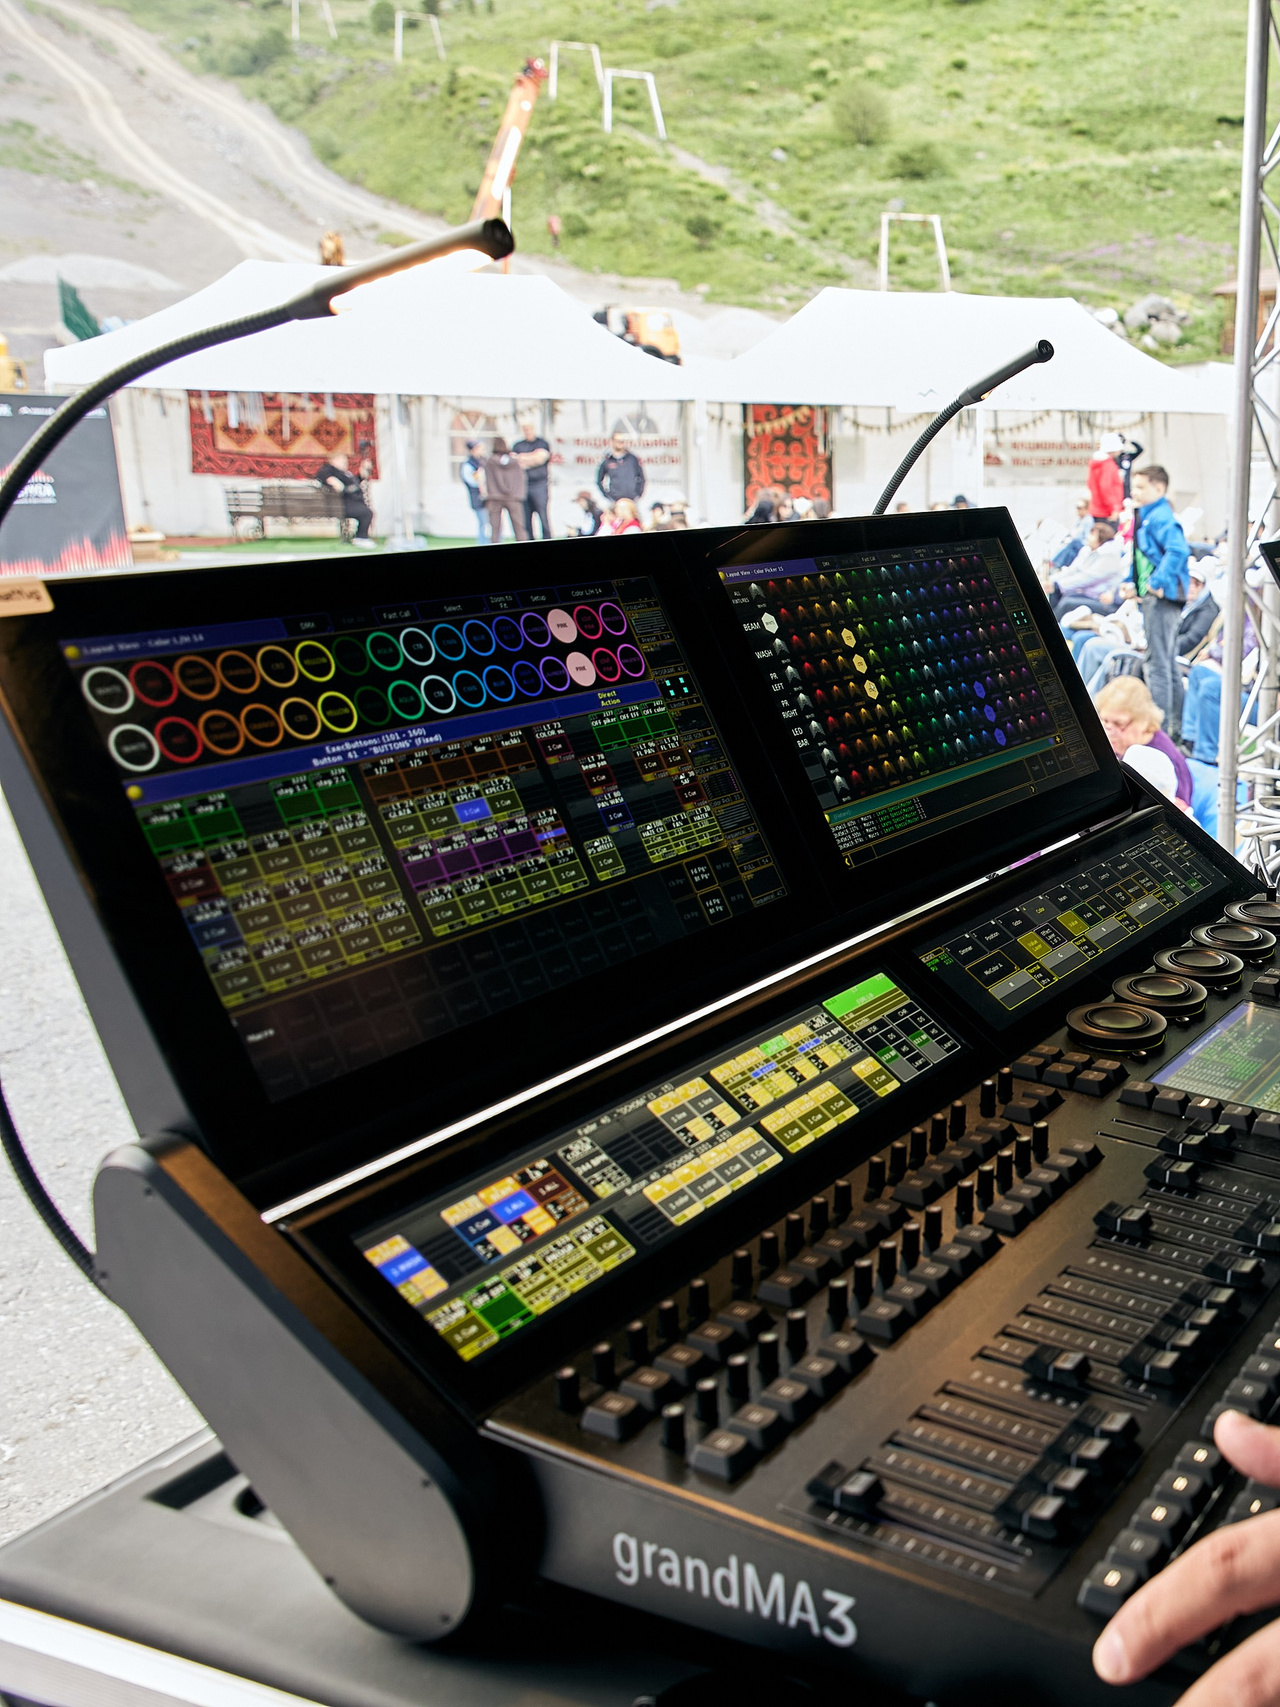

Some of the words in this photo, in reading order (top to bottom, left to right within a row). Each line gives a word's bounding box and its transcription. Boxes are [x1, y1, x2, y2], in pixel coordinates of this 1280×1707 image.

[743, 621, 761, 632] BEAM
[755, 650, 774, 660] WASH
[772, 682, 784, 692] LEFT
[598, 690, 617, 699] Direct
[601, 698, 621, 706] Action
[536, 730, 556, 739] COLOR
[613, 1532, 857, 1647] grandMA3
